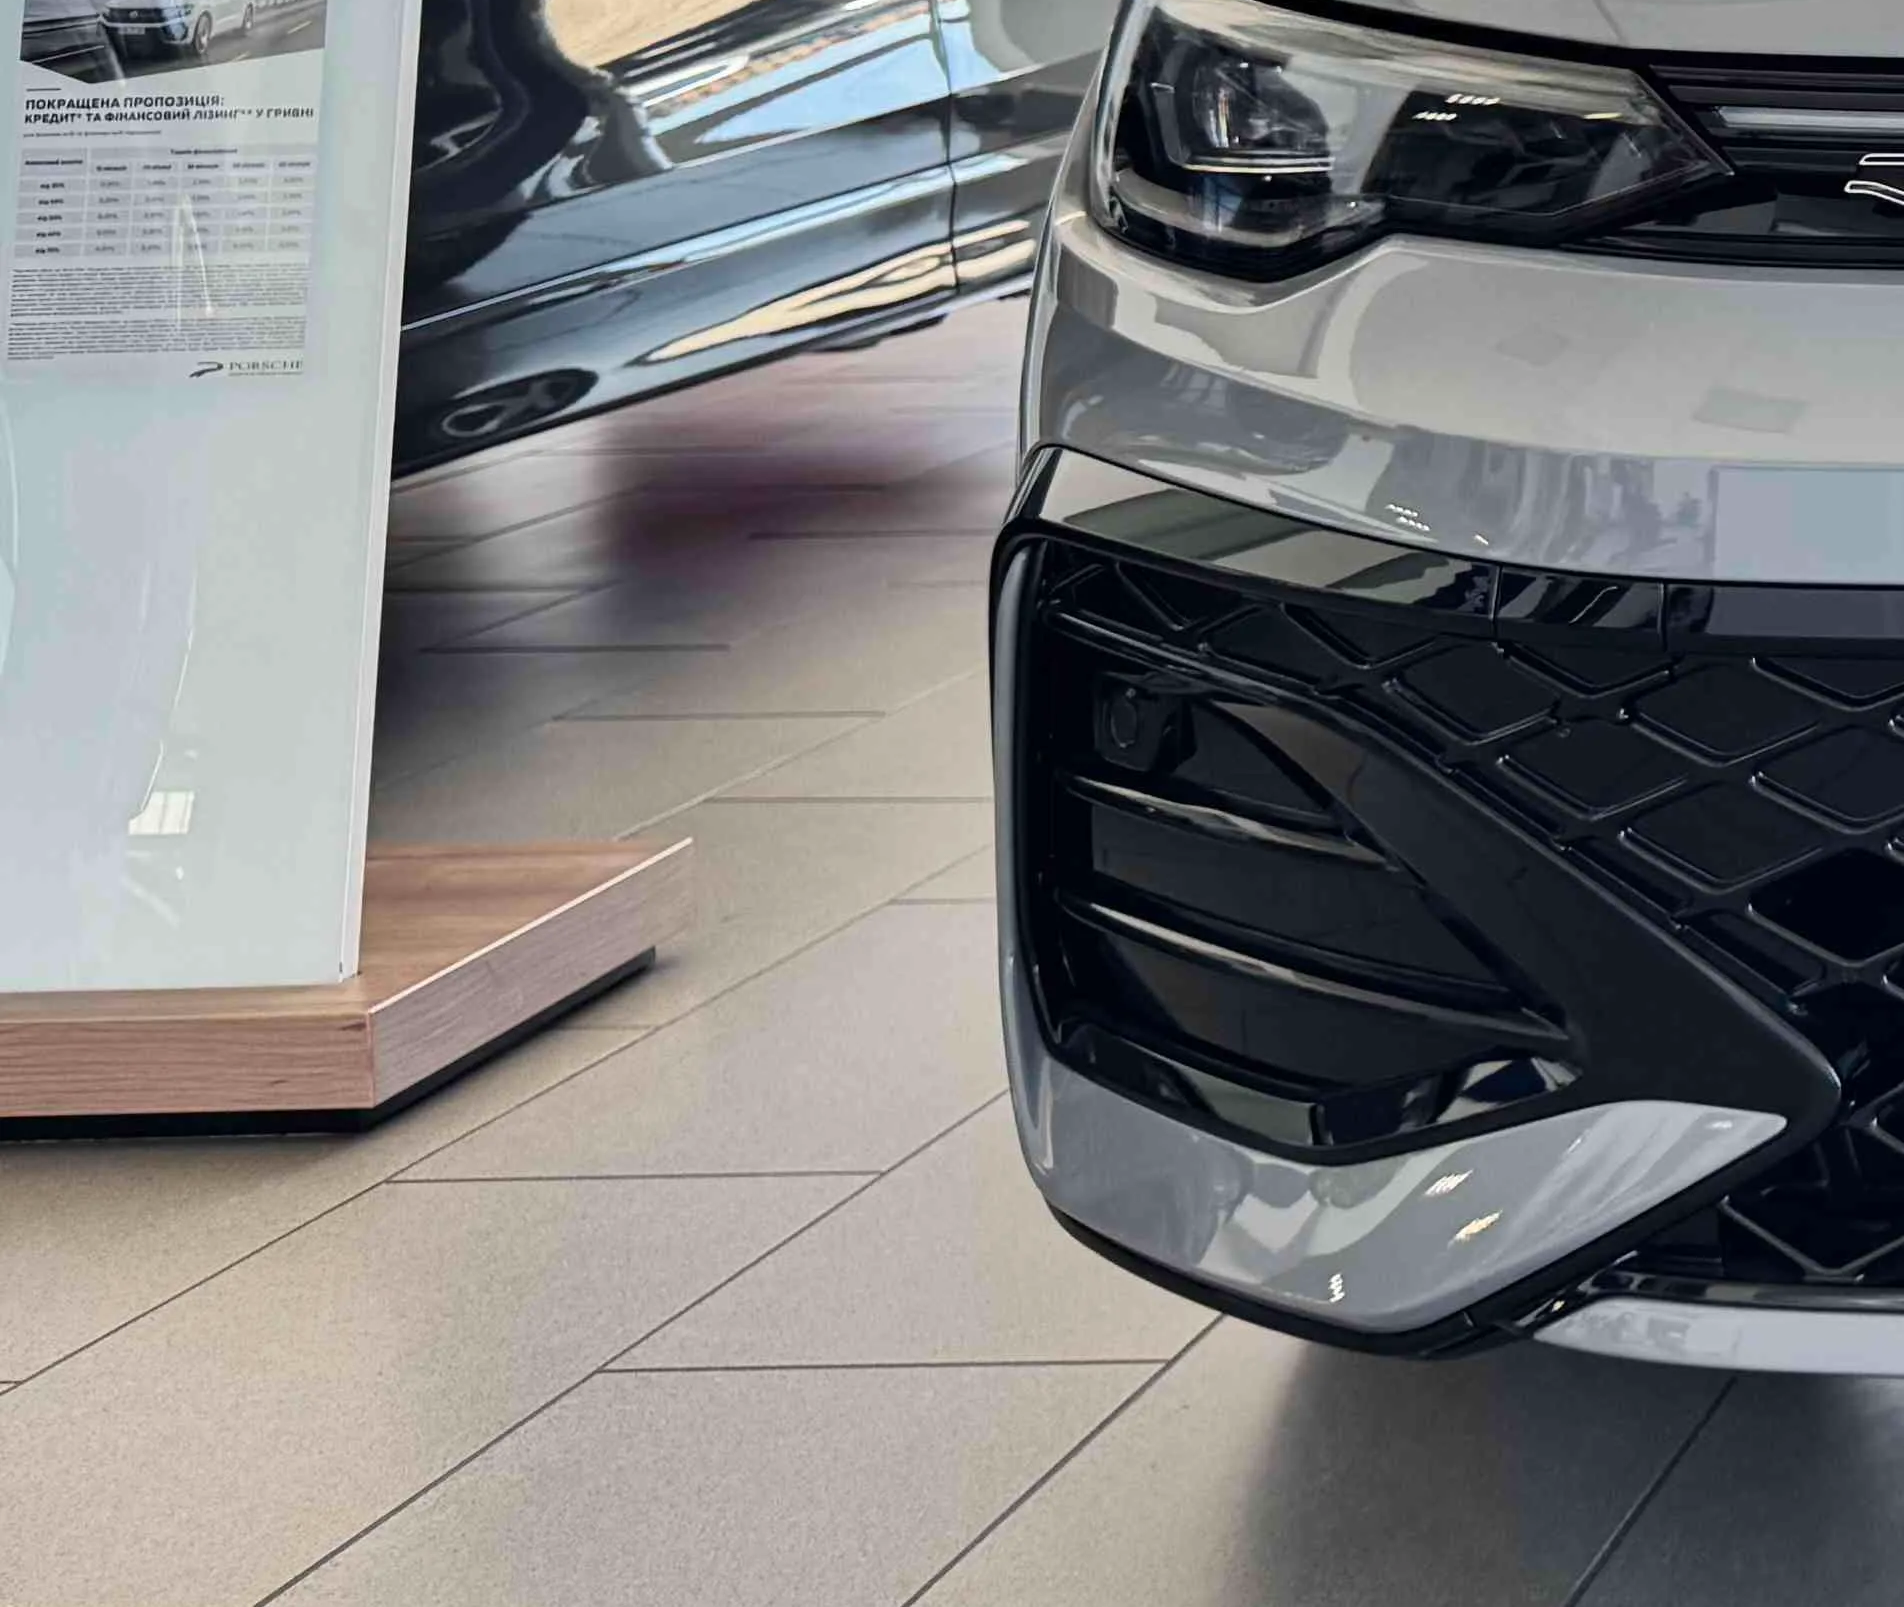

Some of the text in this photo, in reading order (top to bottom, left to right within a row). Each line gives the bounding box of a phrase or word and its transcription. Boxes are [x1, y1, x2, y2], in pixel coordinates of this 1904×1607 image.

[25, 96, 224, 110] ПОКРАЩЕНА ПРОПОЗИЦІЯ:
[86, 113, 102, 121] ТА
[104, 108, 191, 121] ФІНАНСОВИЙ
[266, 108, 314, 118] ГРИВНІ
